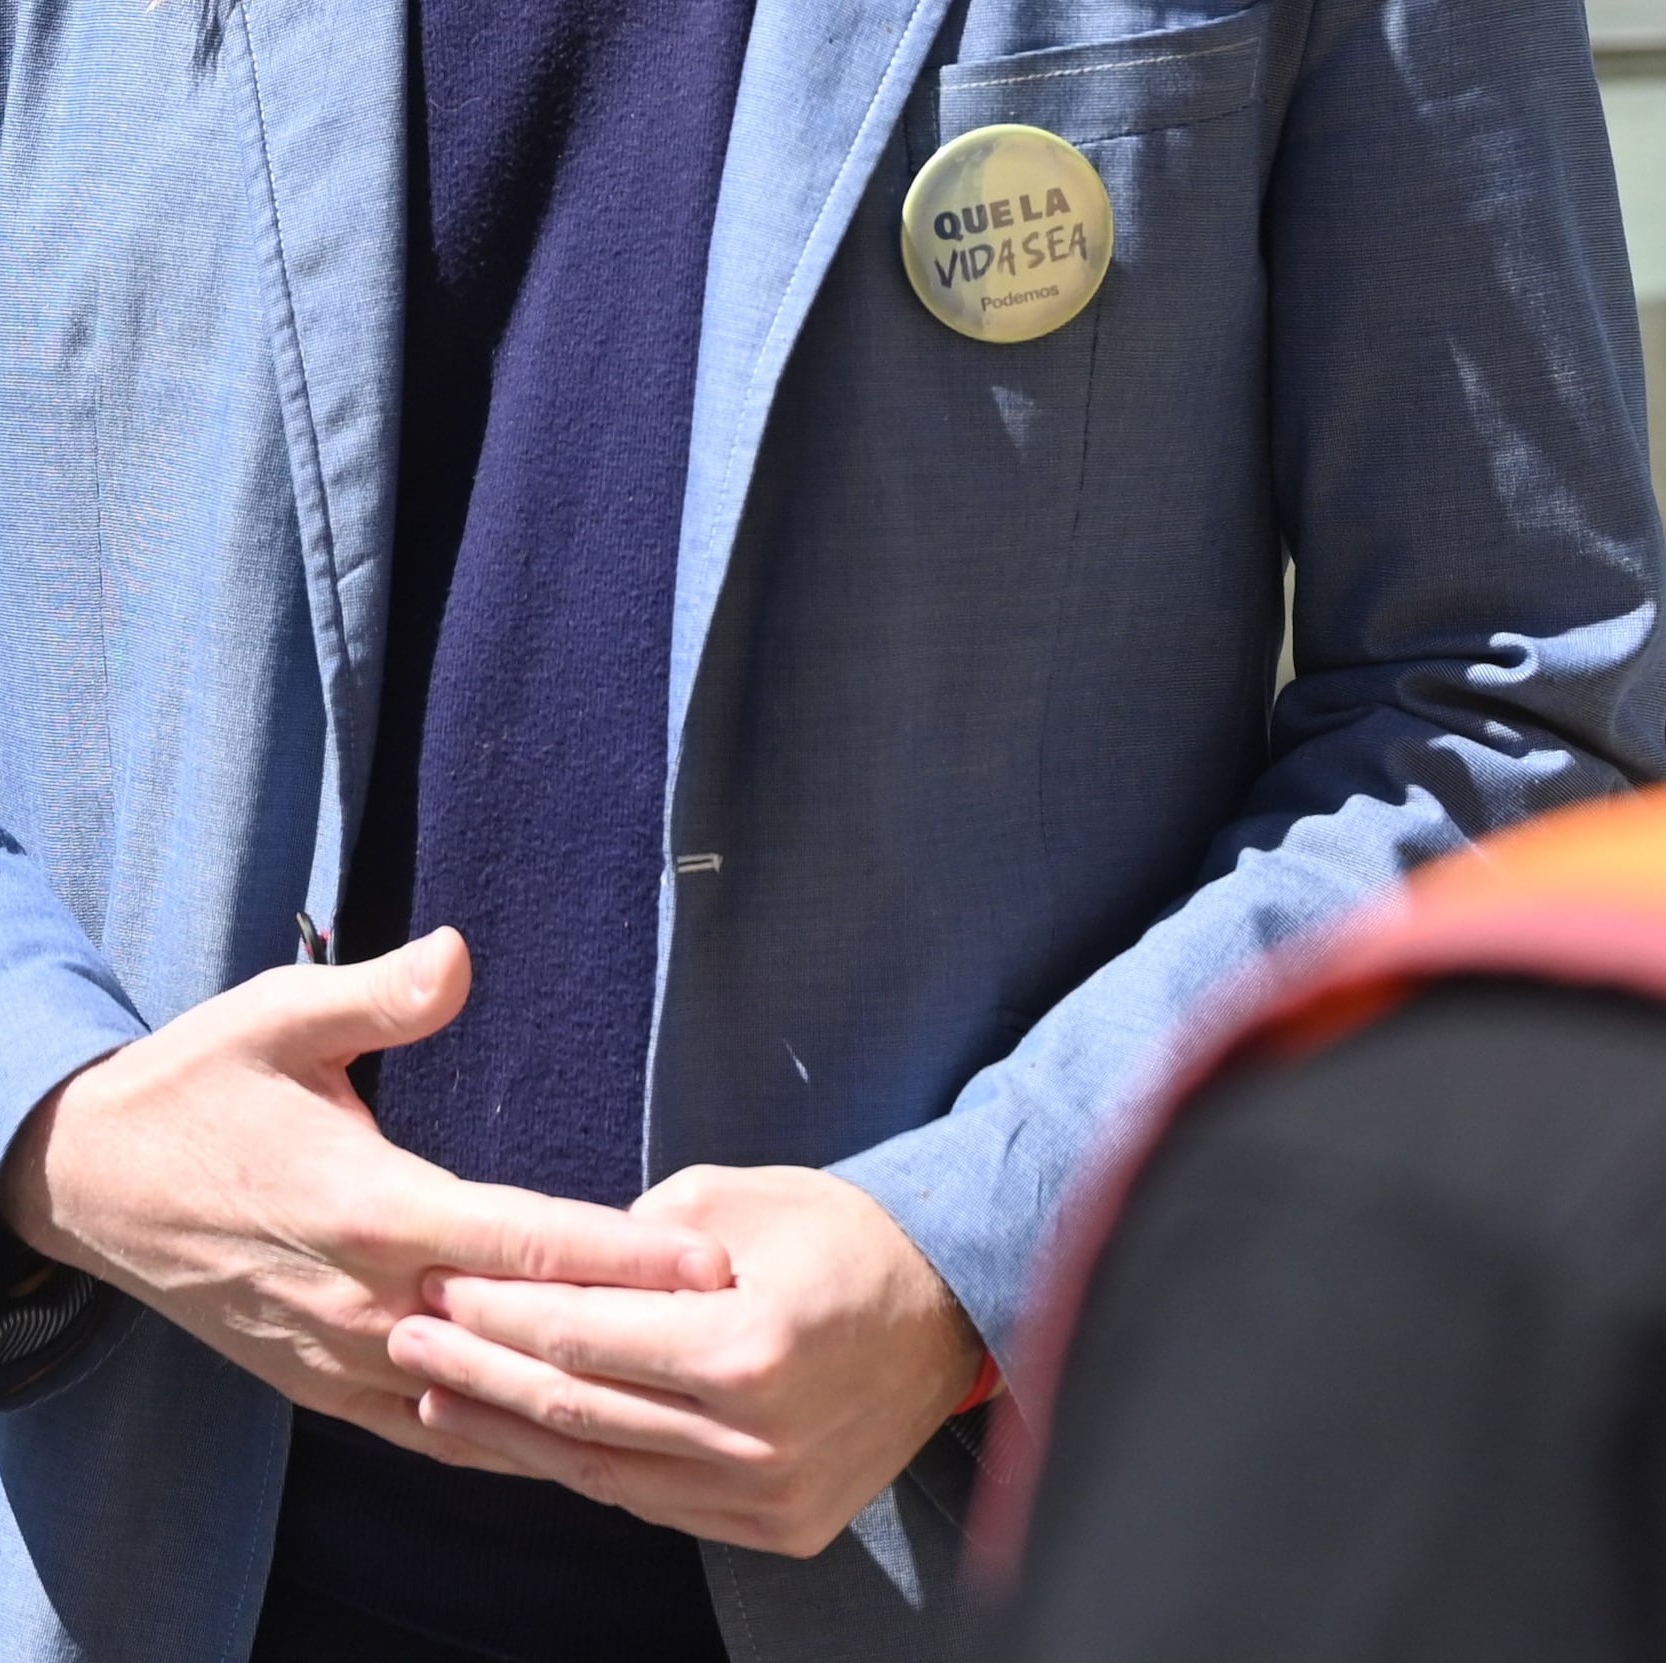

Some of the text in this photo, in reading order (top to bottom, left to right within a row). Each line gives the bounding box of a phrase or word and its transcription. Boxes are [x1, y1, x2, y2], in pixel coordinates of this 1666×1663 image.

[934, 187, 1071, 242] QUE LA
[934, 222, 1088, 289] VIDA SEA
[980, 285, 1060, 312] Podemos
